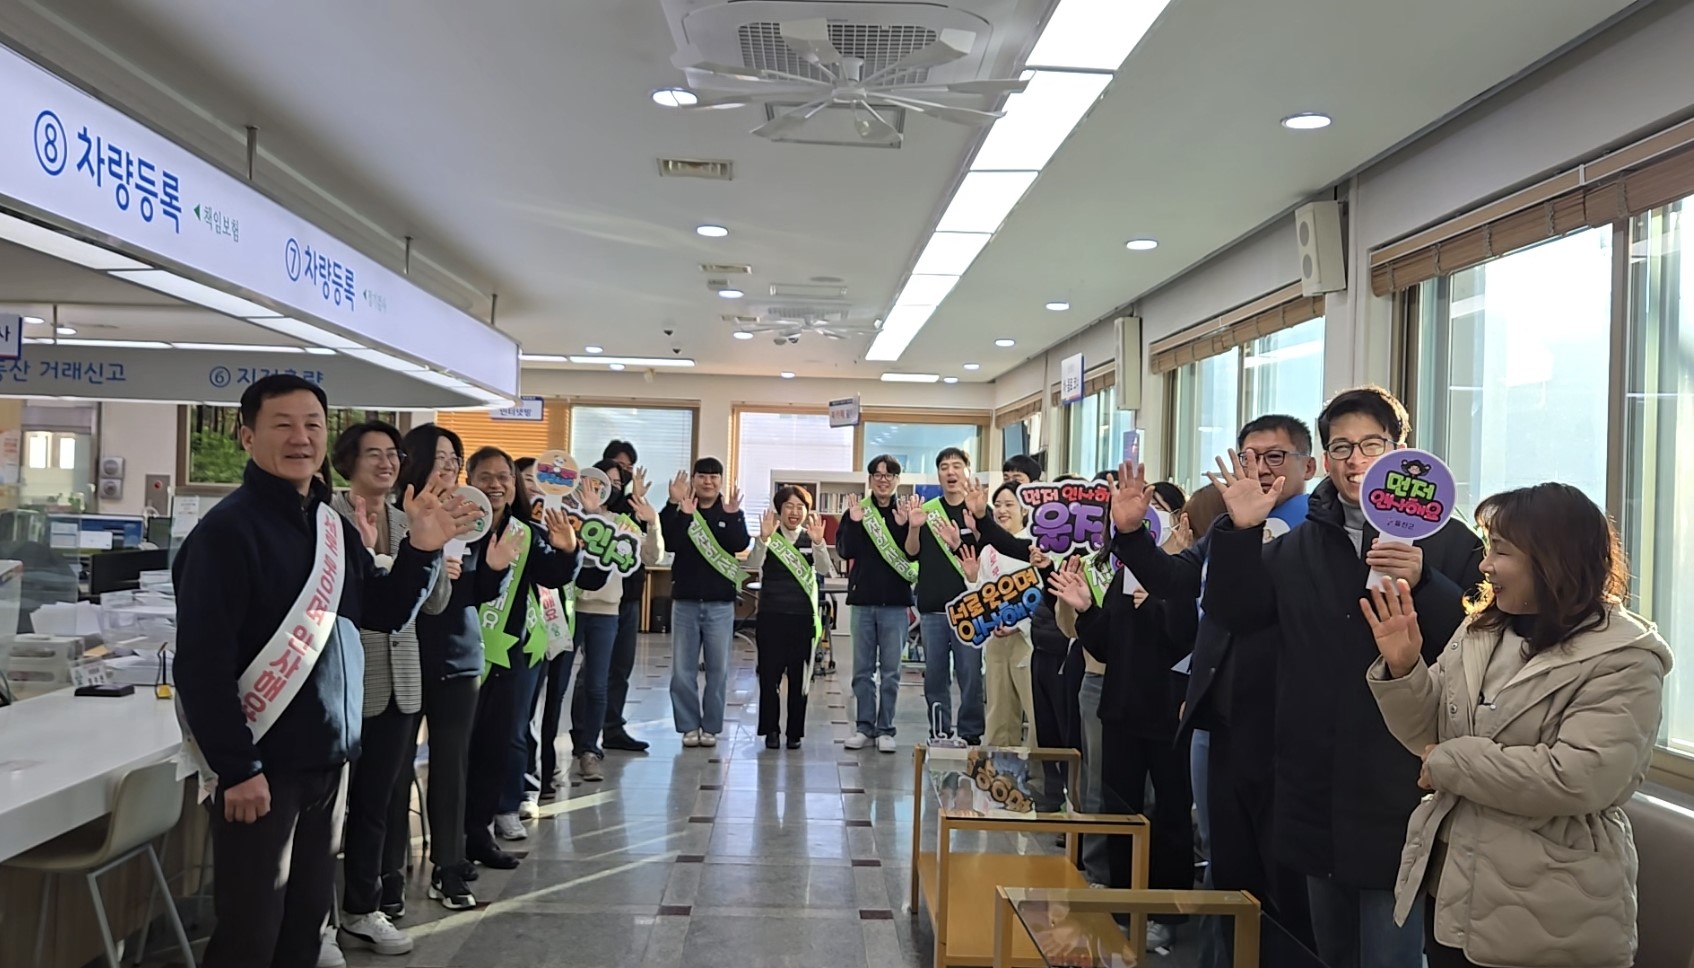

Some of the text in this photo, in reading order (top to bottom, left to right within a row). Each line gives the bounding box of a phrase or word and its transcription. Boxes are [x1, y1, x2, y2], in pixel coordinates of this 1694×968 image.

[76, 126, 182, 234] 차량등록
[204, 206, 239, 243] 책임보험
[304, 245, 355, 311] 차량등록
[40, 361, 126, 384] 거래신고
[1022, 488, 1059, 505] 먼저
[1369, 490, 1442, 521] 인사해요
[1387, 472, 1435, 500] 먼저
[949, 567, 1039, 625] 서로 웃으며
[957, 587, 1042, 645] 인사해요
[242, 624, 315, 723] 인사해요
